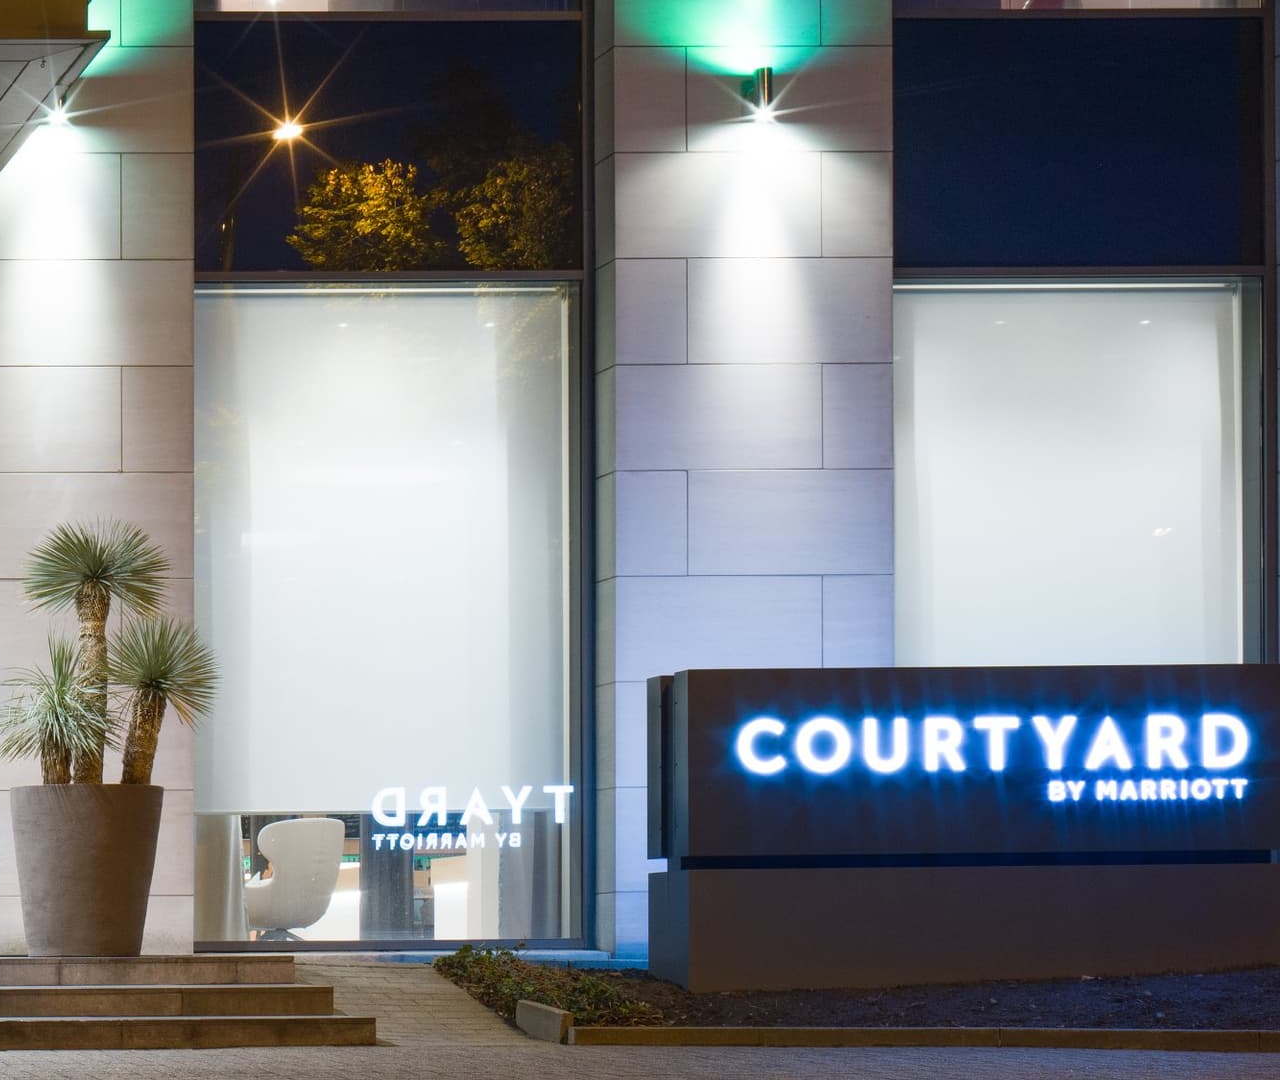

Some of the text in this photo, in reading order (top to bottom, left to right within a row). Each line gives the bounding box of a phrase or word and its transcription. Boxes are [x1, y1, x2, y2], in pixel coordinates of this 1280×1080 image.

[736, 713, 1251, 775] COURTYARD
[1048, 778, 1249, 802] BY MARRIOTT
